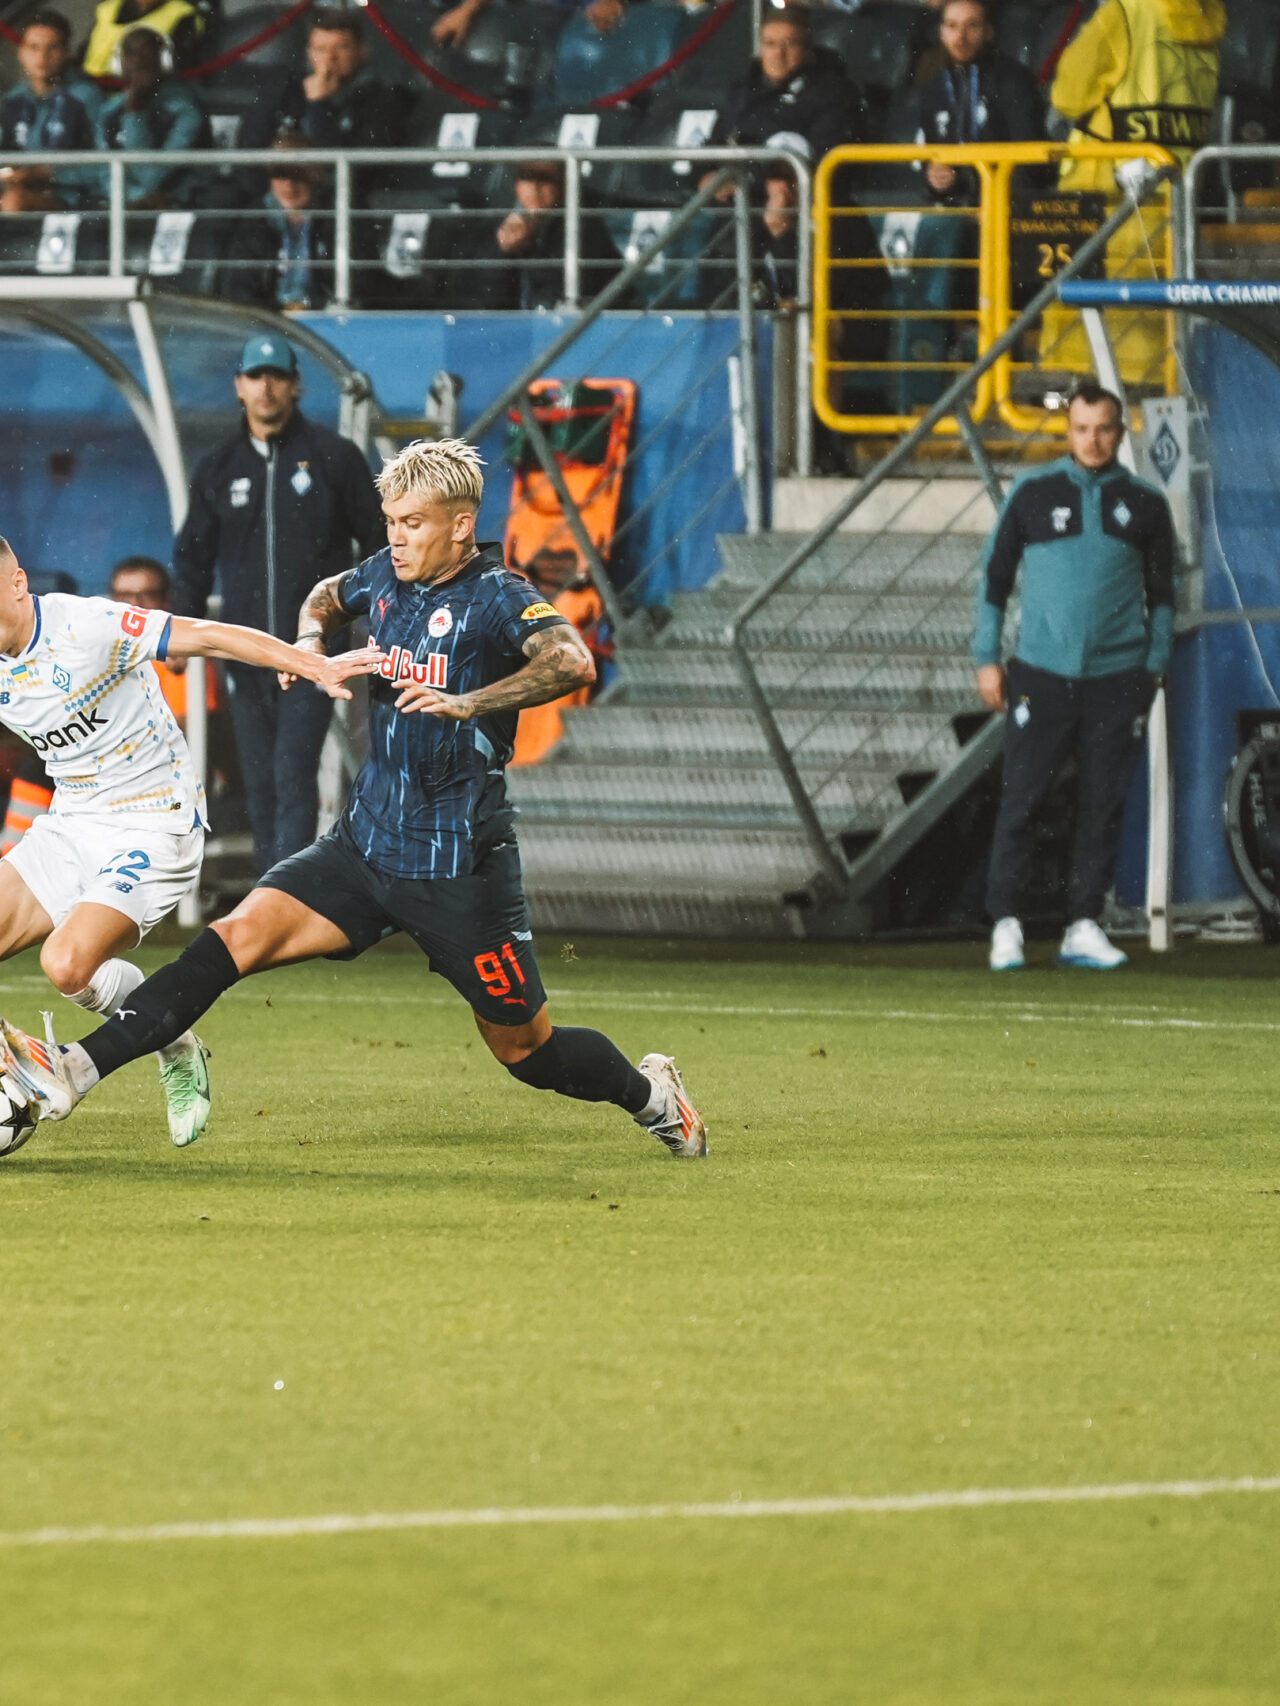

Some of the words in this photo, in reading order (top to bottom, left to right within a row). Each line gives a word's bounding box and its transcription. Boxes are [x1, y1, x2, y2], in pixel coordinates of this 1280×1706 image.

[1167, 284, 1214, 304] UEFA
[399, 649, 448, 688] Bull
[23, 707, 109, 752] bank
[474, 942, 526, 997] 91
